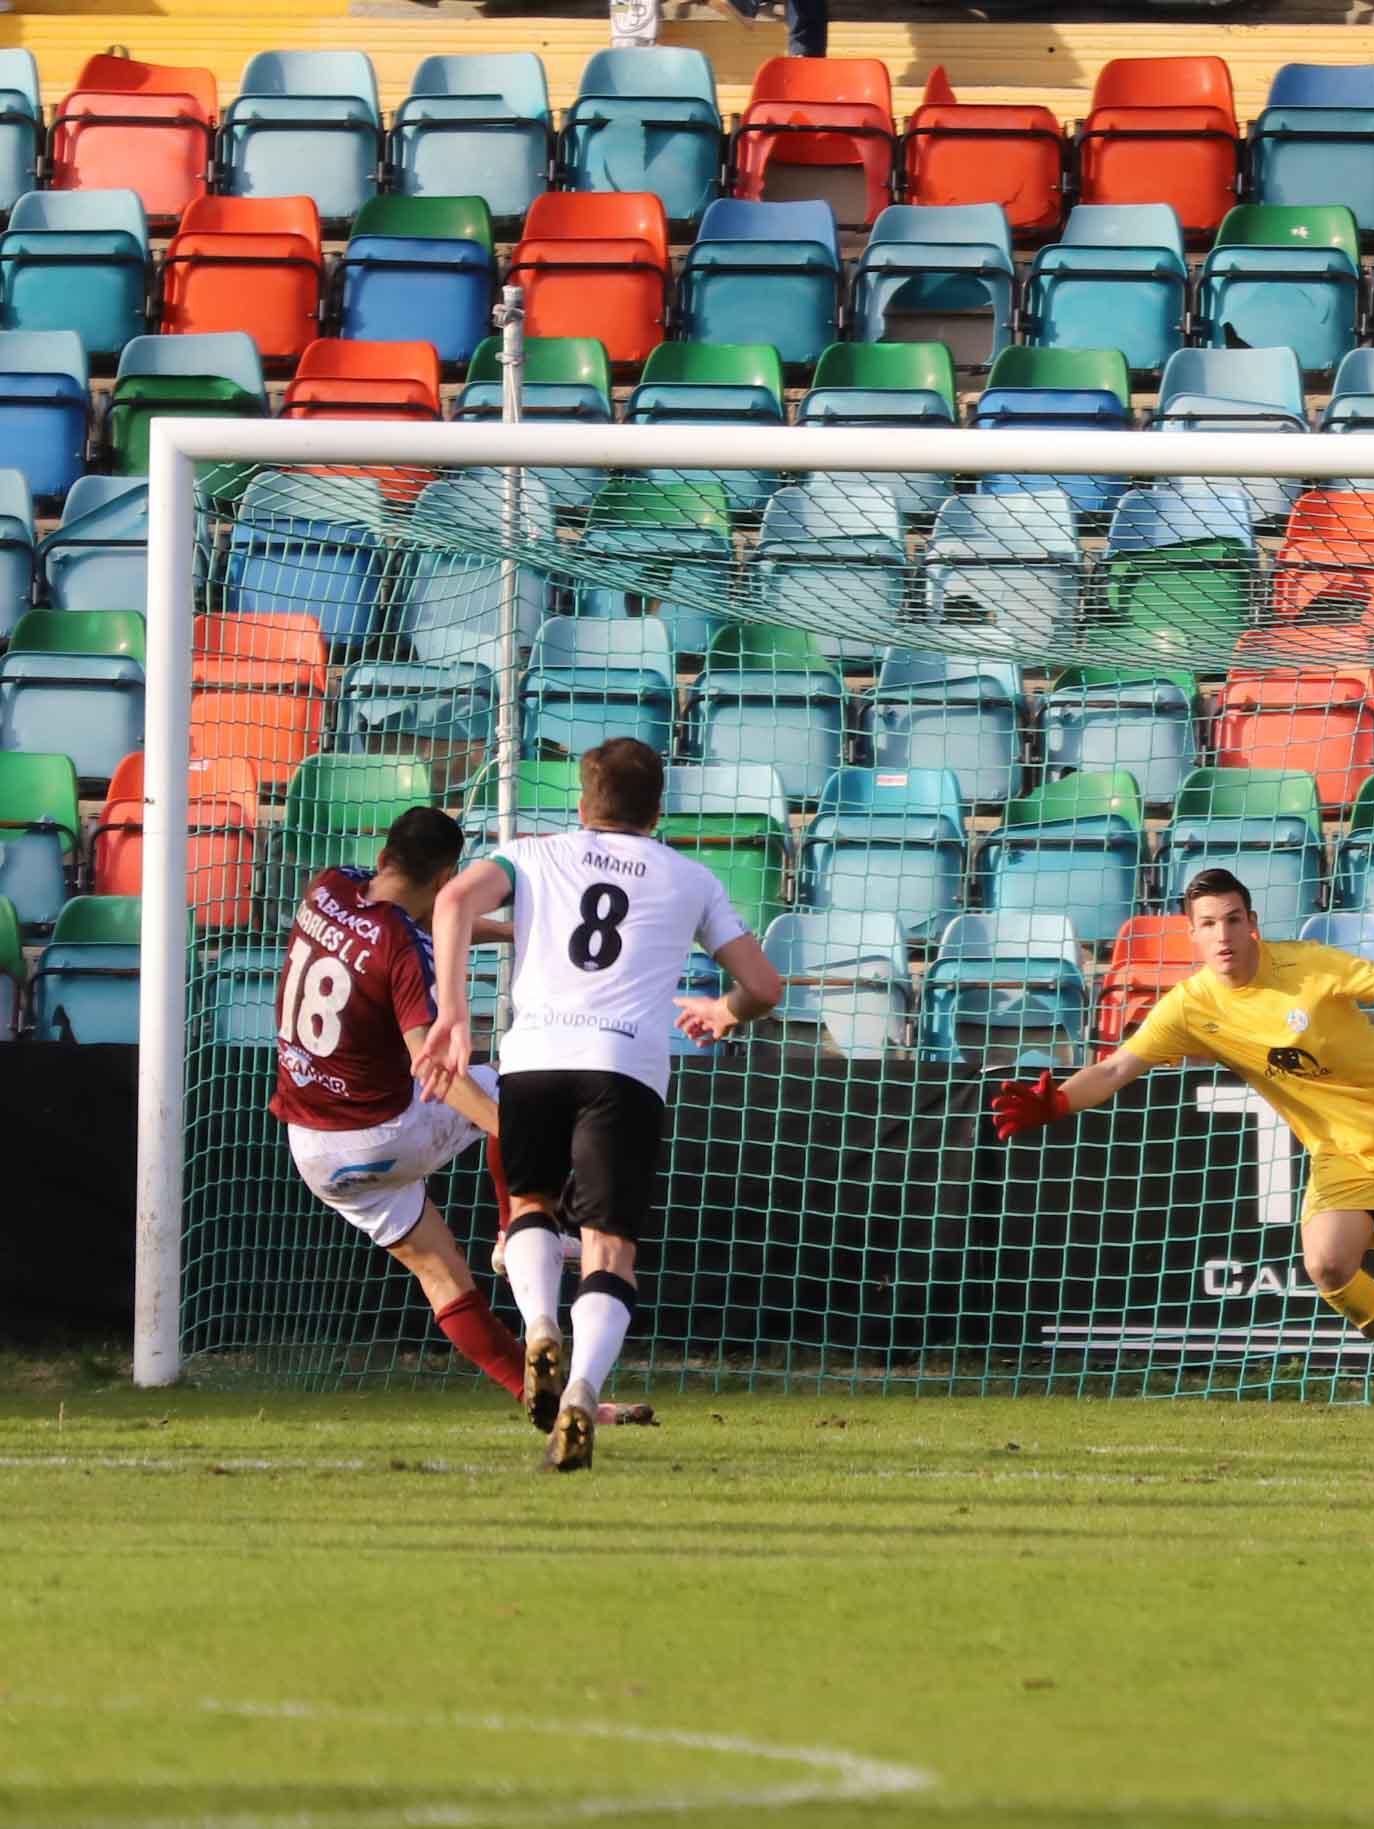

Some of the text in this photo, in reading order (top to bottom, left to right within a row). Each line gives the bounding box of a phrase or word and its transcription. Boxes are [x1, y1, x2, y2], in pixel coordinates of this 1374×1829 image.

[581, 851, 647, 878] AMARO
[568, 882, 629, 972] 8
[279, 937, 352, 1058] 18
